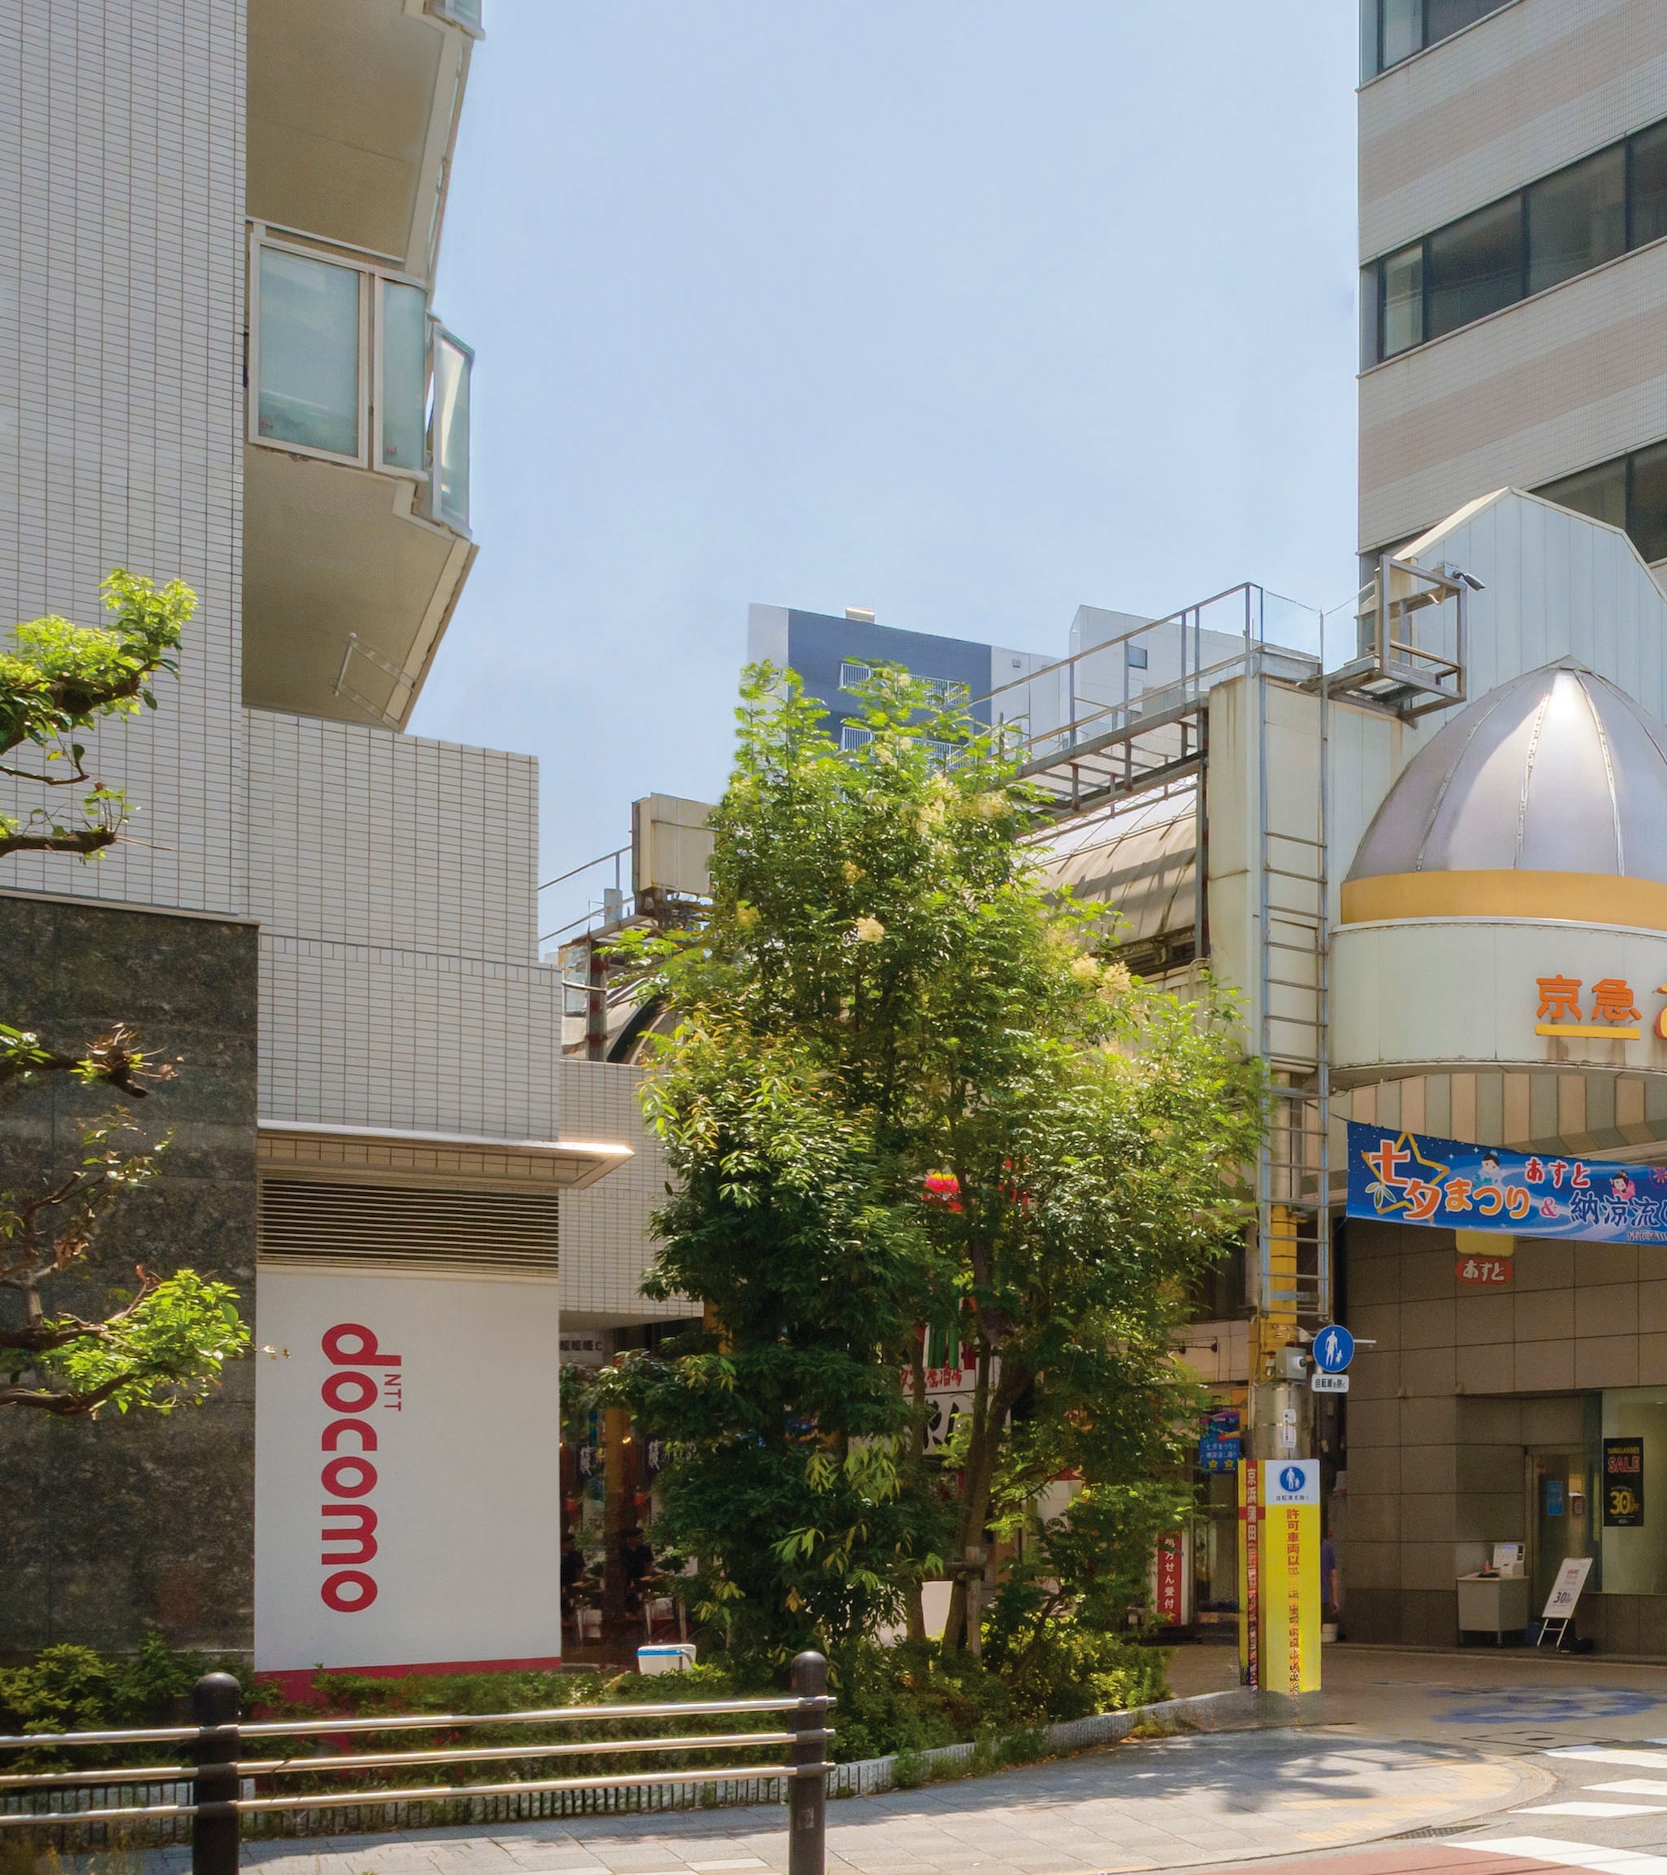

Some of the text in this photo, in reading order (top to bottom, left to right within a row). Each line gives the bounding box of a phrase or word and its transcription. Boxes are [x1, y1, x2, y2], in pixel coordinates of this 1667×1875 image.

[1535, 974, 1643, 1023] 京急
[1369, 1138, 1531, 1220] 七夕まつり
[1540, 1201, 1558, 1218] &
[1524, 1156, 1591, 1189] あすと
[1462, 1259, 1505, 1282] あすと
[384, 1374, 402, 1412] NTT
[321, 1323, 402, 1613] docomo
[1607, 1456, 1640, 1473] SALE
